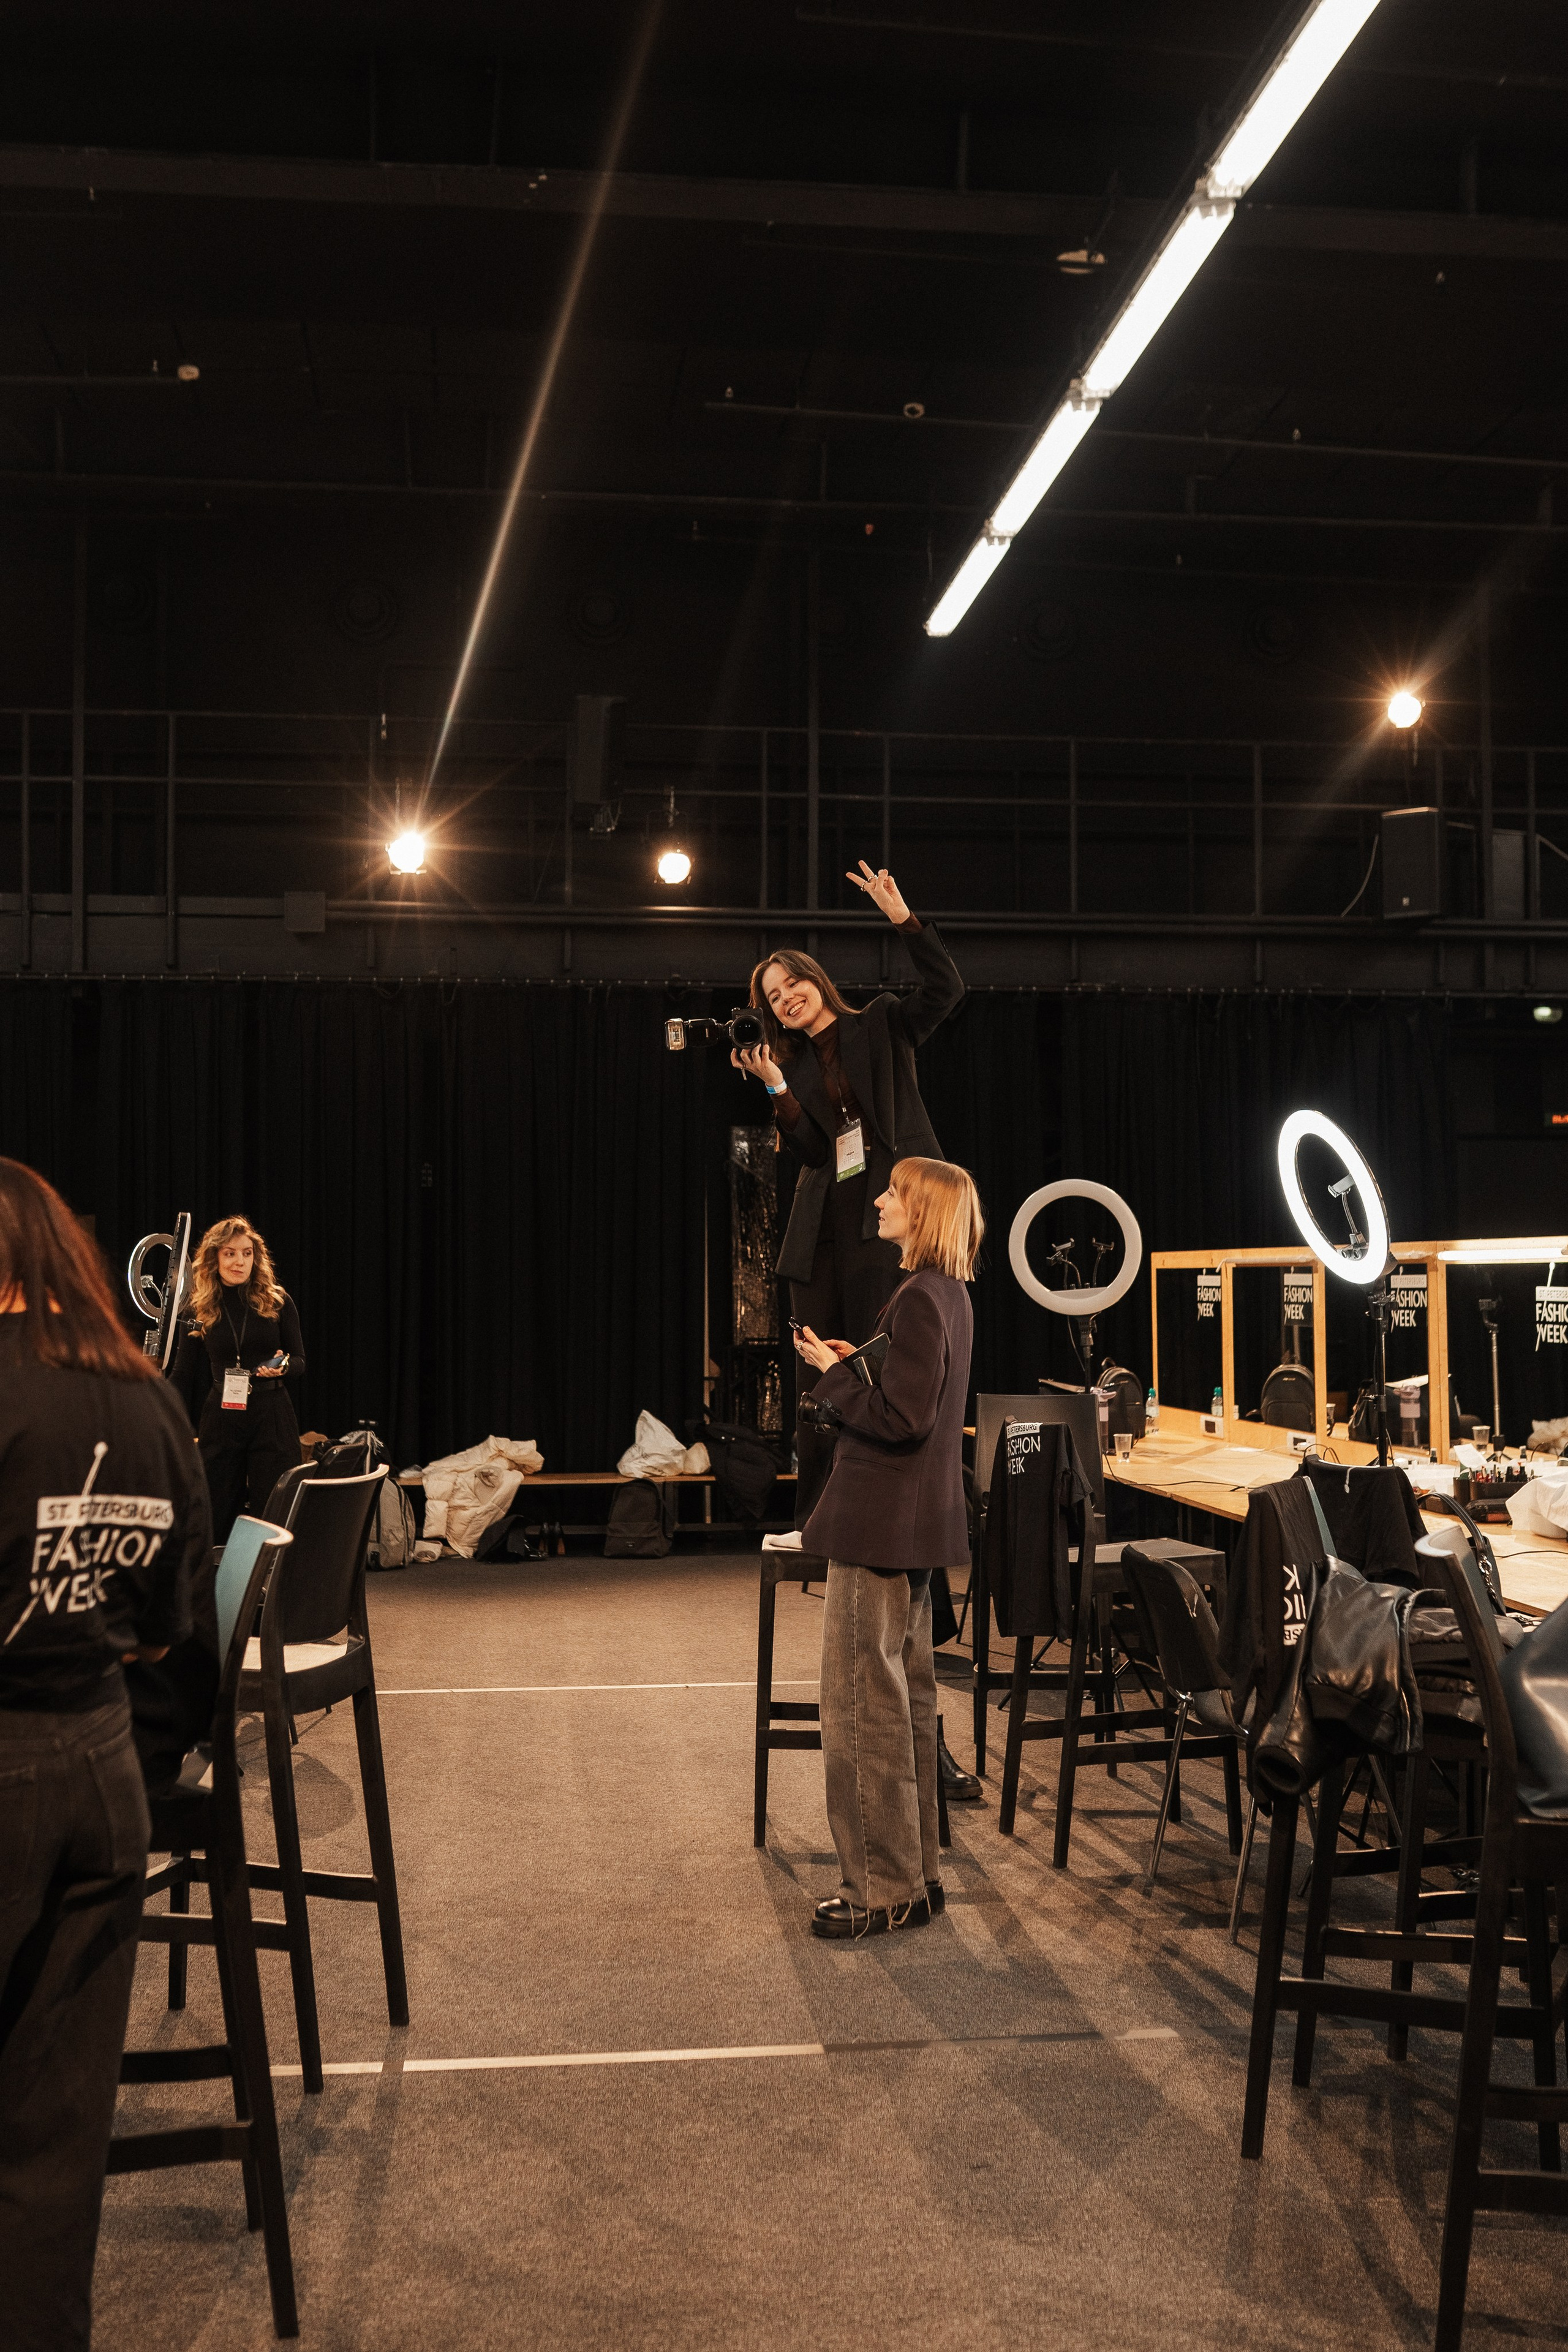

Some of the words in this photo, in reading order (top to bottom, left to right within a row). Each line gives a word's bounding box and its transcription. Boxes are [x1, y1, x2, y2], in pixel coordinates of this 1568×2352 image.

[1197, 1287, 1221, 1302] FASHION
[1284, 1287, 1313, 1303] FASHION
[1197, 1303, 1214, 1317] WEEK
[1284, 1303, 1304, 1320] WEEK
[1391, 1310, 1416, 1327] WEEK
[1536, 1324, 1568, 1344] WEEK
[1008, 1436, 1041, 1457] ASHION
[29, 1567, 117, 1615] WEK
